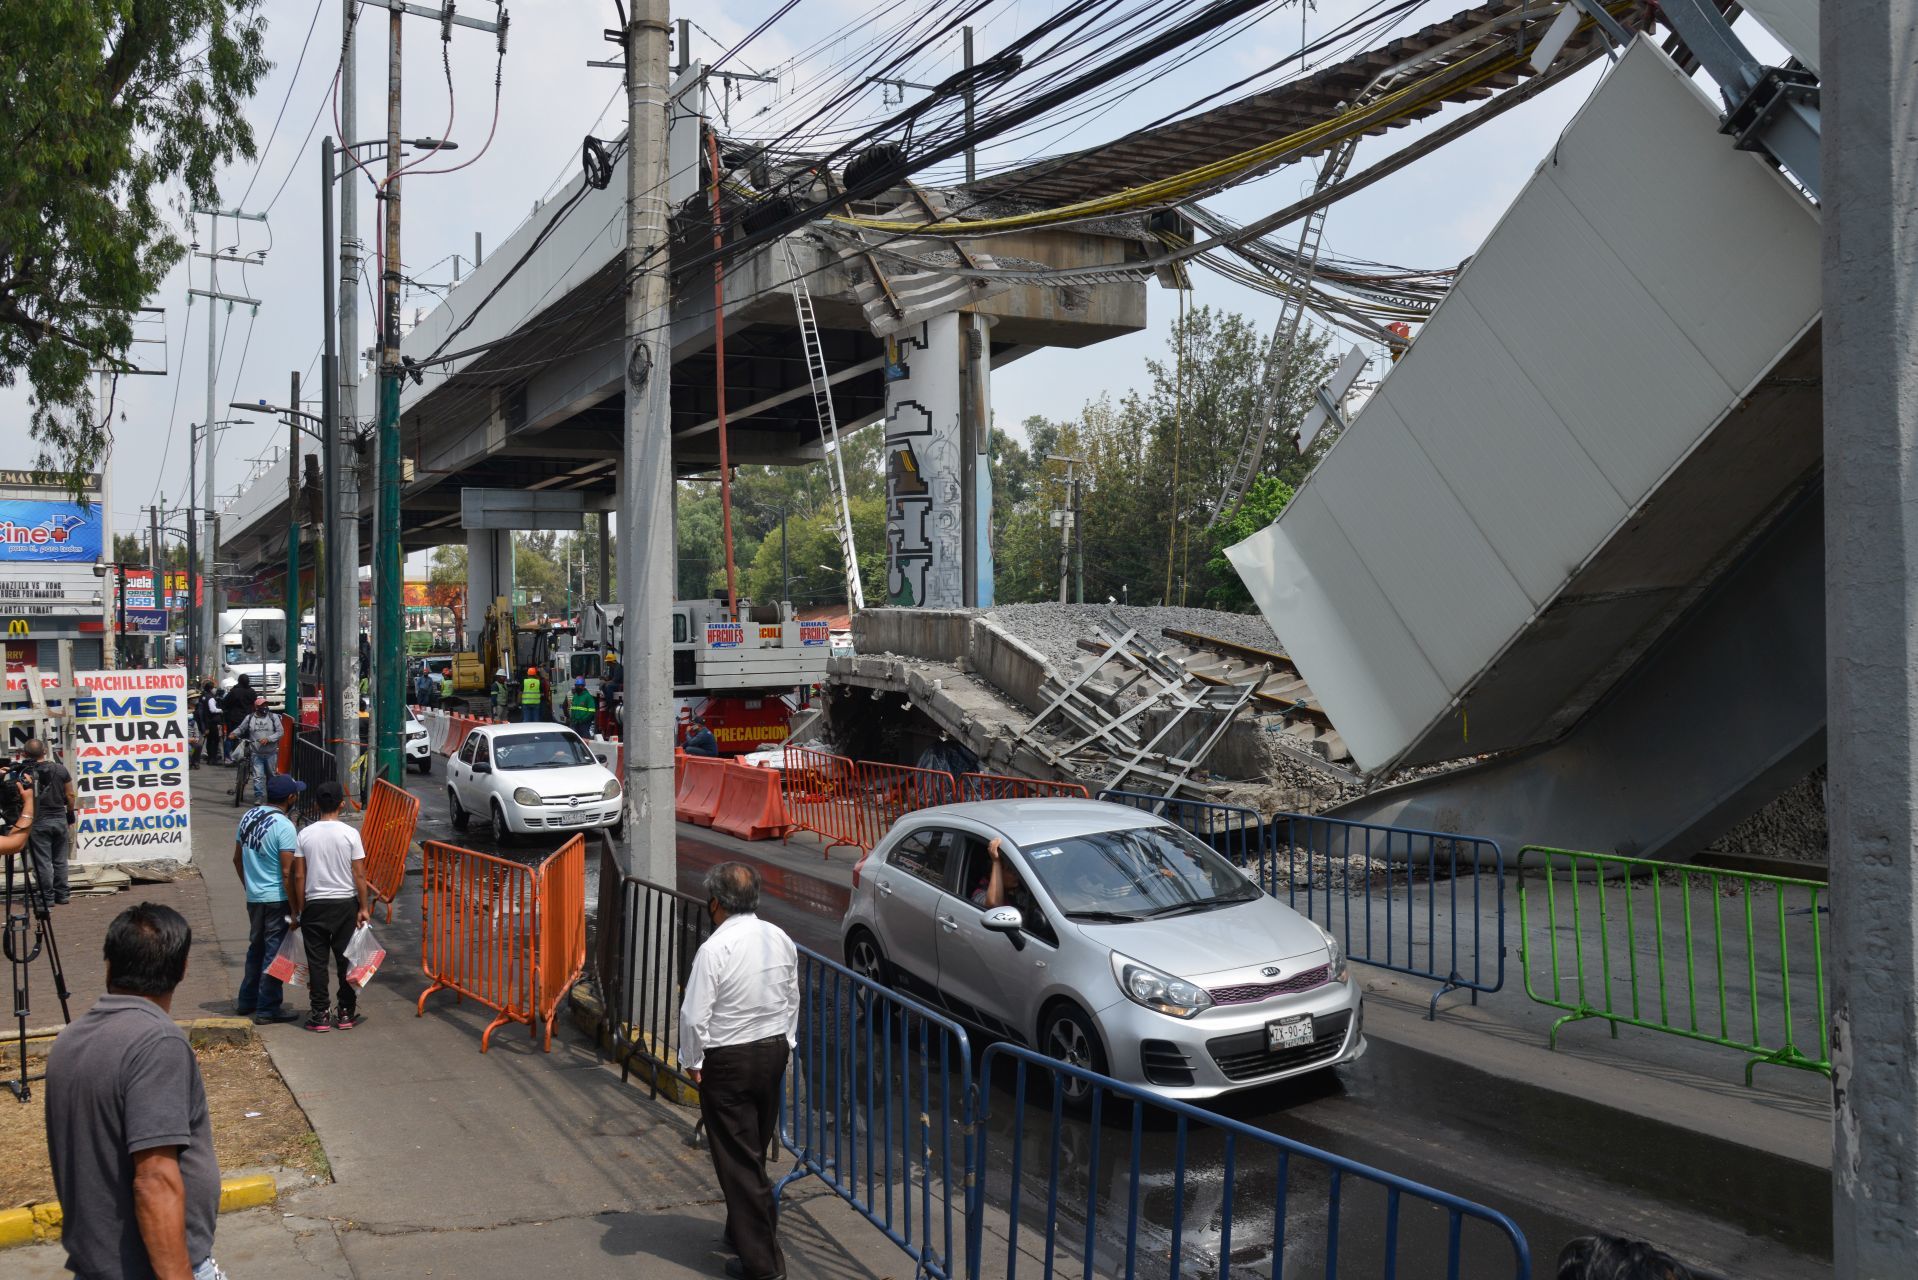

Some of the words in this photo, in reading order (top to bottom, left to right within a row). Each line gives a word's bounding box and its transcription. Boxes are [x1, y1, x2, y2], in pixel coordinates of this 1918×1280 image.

[132, 615, 162, 625] telcel
[707, 629, 744, 644] HERCULES
[800, 627, 829, 641] HERCULES
[85, 675, 185, 691] BACHILLERATO
[714, 724, 789, 742] PRECAUCION
[95, 831, 182, 847] SECUNDARIA
[1263, 967, 1280, 976] KIA
